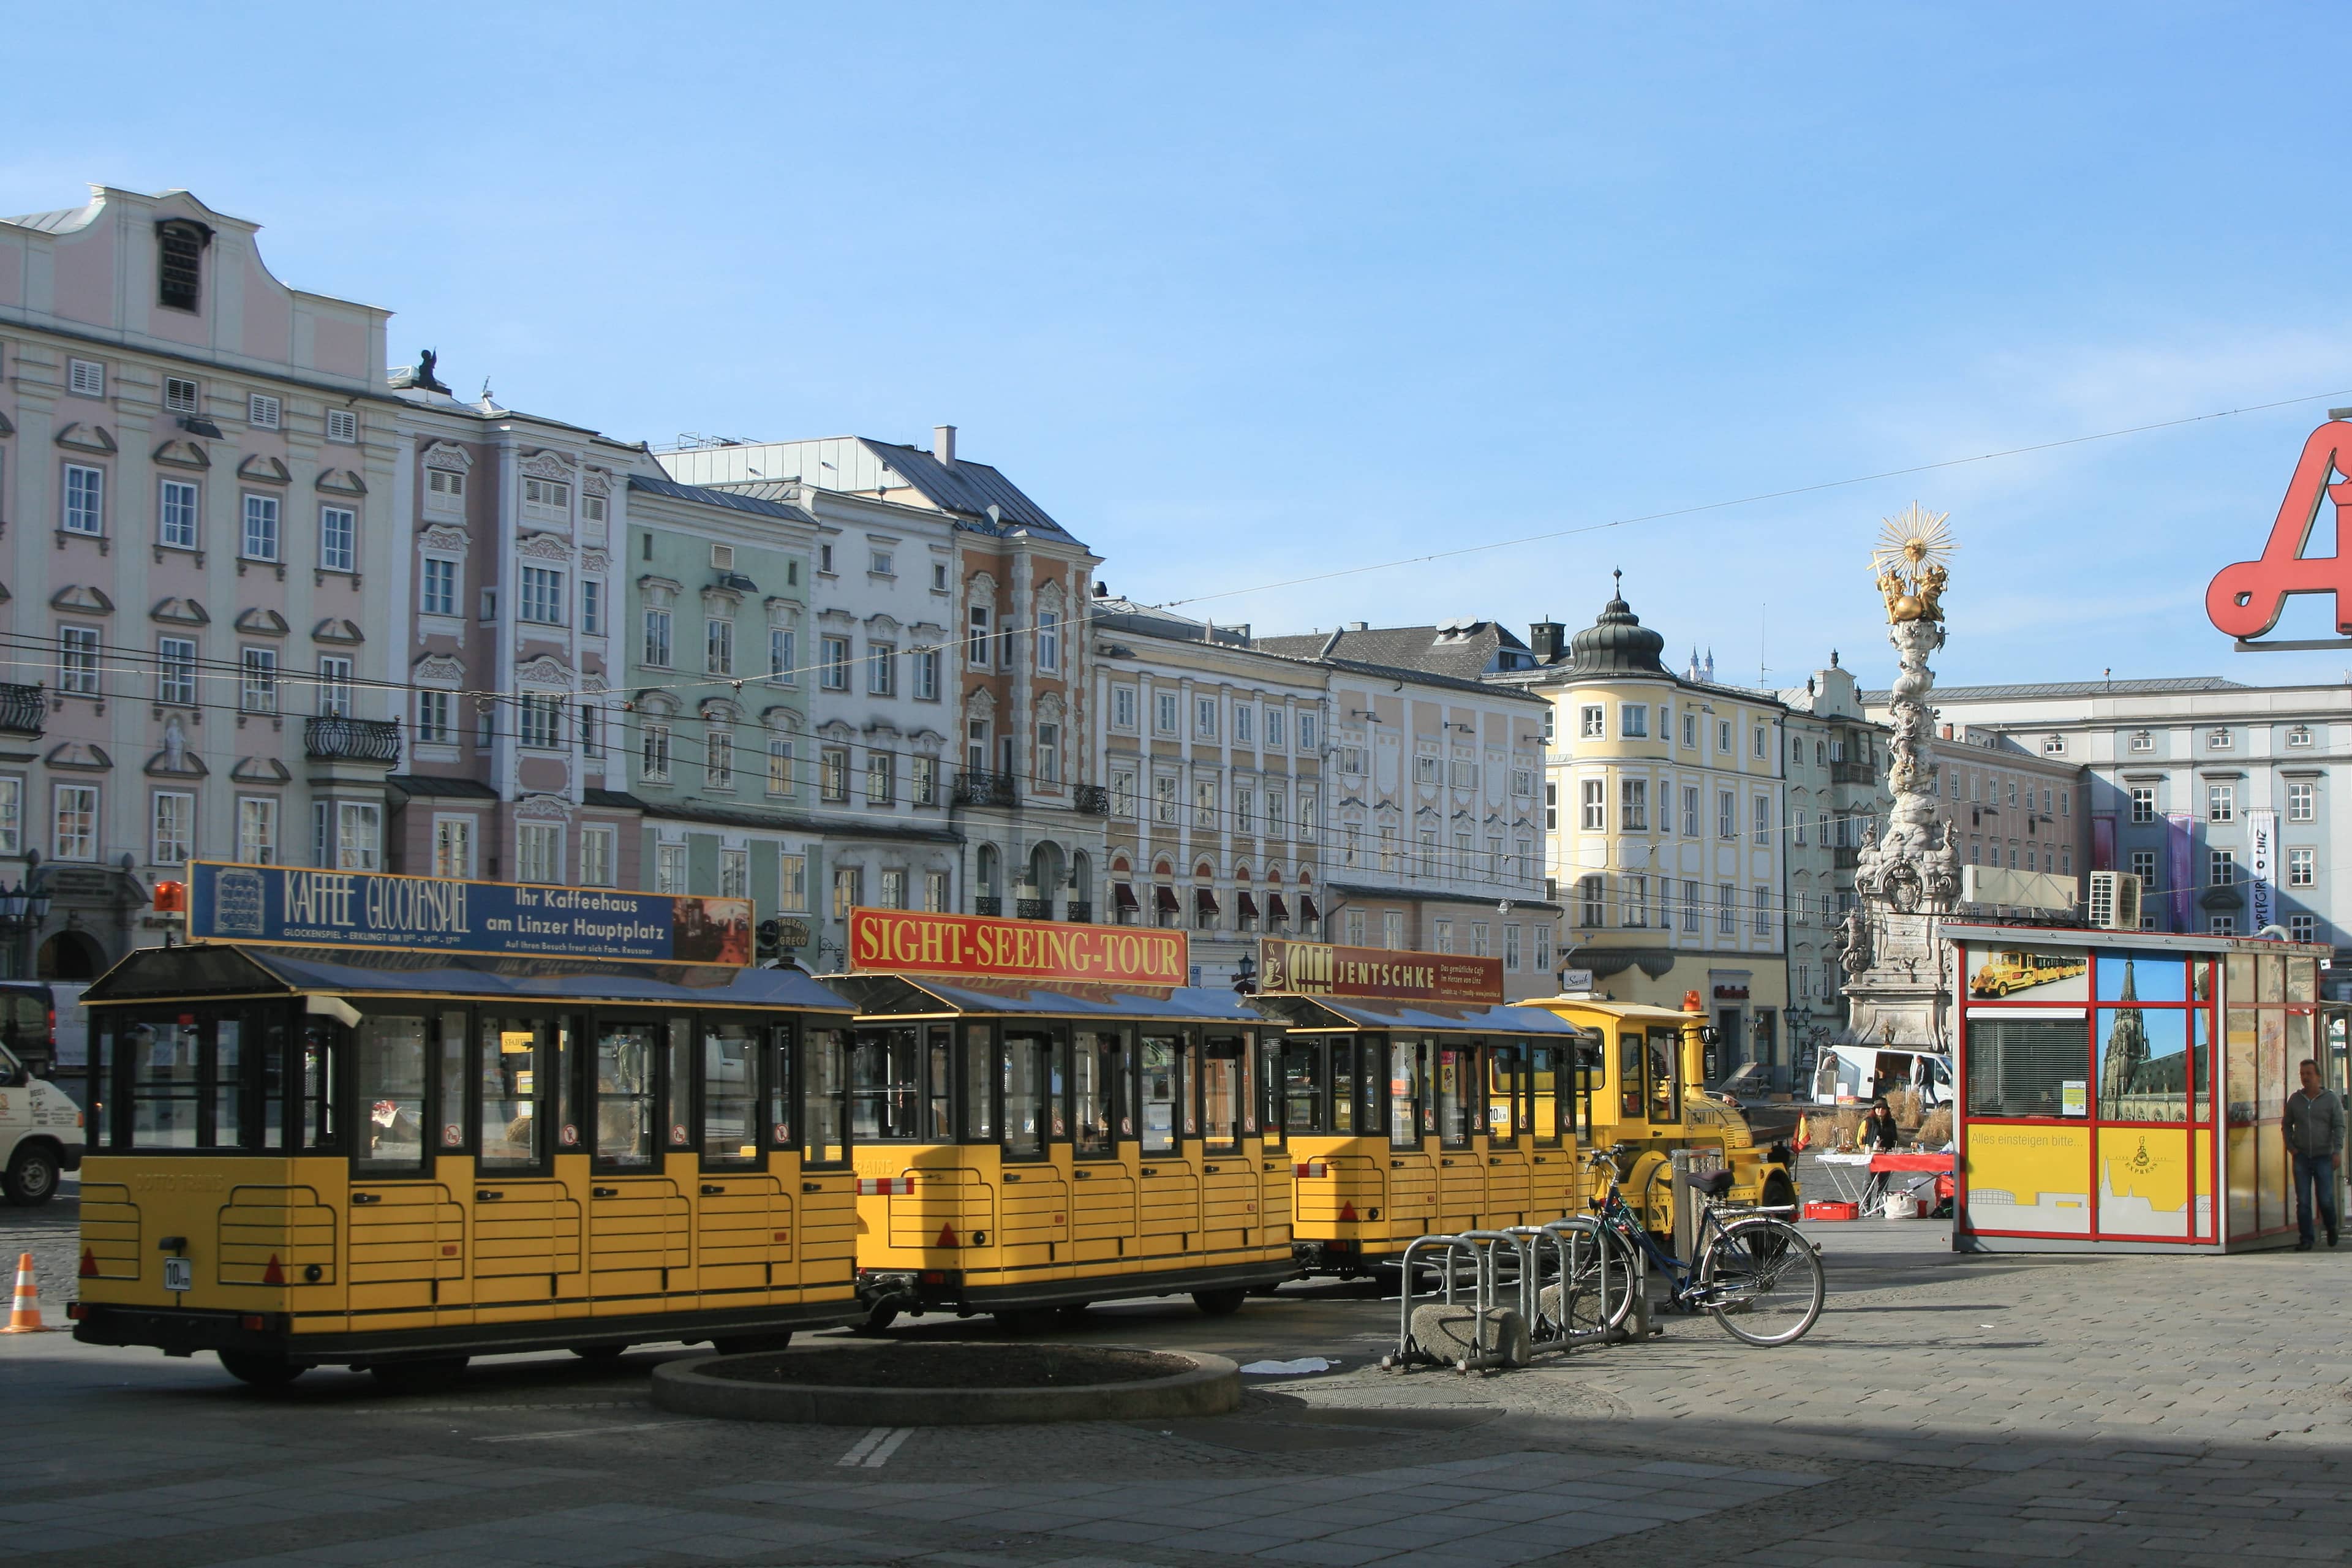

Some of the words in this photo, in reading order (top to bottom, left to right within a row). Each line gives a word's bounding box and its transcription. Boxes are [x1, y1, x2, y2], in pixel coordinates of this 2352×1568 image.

[284, 870, 356, 926] KAFFEE
[366, 876, 470, 933] GLOCKENSPIEL
[515, 888, 538, 907] Ihr
[544, 889, 638, 913] Kaffeehaus
[284, 928, 341, 940] GLOCKENSPIEL
[349, 932, 386, 941] ERKLINGT
[486, 919, 512, 931] am
[518, 915, 569, 934] Linzer
[574, 918, 665, 941] Hauptplatz
[521, 941, 540, 949] Ihren
[541, 942, 567, 951] Besuch
[588, 944, 602, 952] sich
[604, 945, 620, 954] Fam.
[779, 936, 806, 946] GRECO
[860, 917, 1180, 976] SIGHT-SEEING-TOUR
[1338, 960, 1434, 989] JENTSCHKE
[1971, 1133, 1995, 1144] Alles
[1998, 1134, 2048, 1147] einsteigen
[853, 1159, 894, 1175] RAINS
[2125, 1161, 2158, 1175] EXPRESS
[167, 1263, 179, 1285] 10
